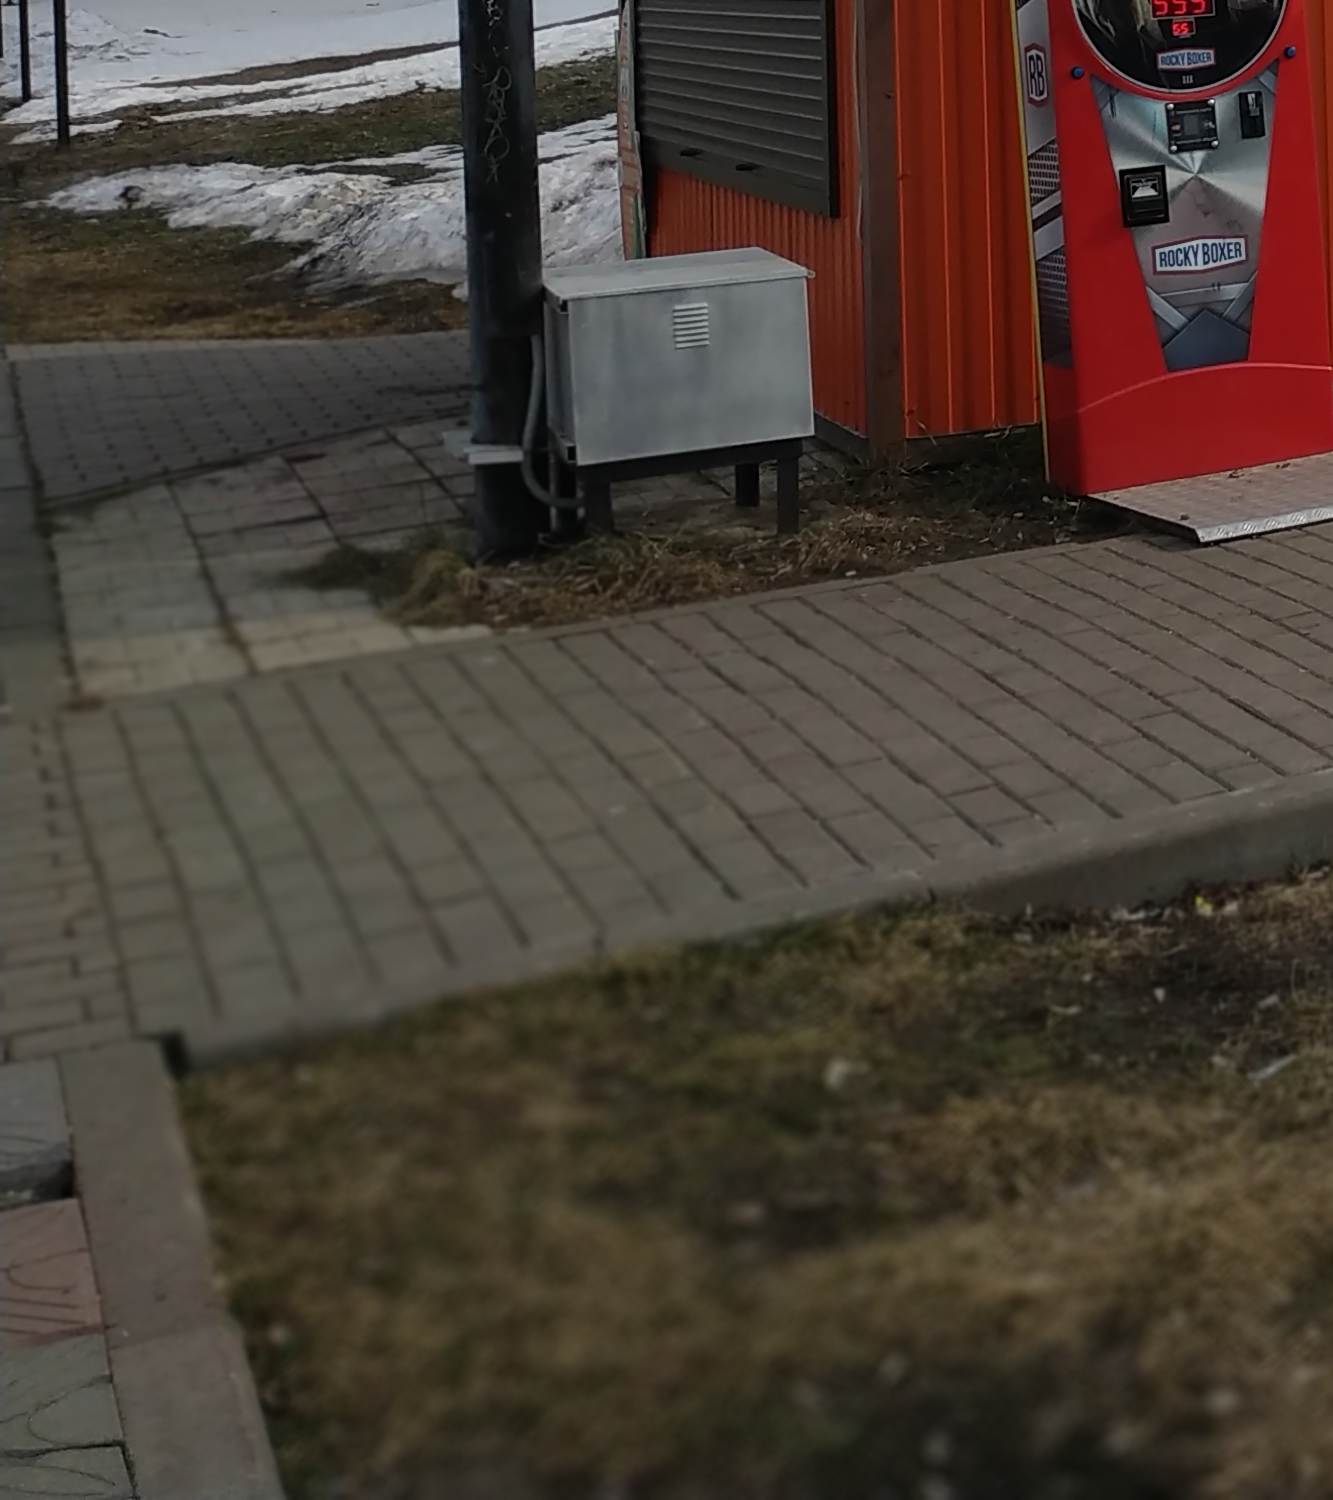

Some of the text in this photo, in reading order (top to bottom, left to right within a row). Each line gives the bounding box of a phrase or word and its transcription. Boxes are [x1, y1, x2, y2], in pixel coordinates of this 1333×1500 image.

[1160, 52, 1211, 66] ROCKY BOXER
[1028, 53, 1045, 97] RB
[1159, 242, 1242, 267] ROCKY BOXER
